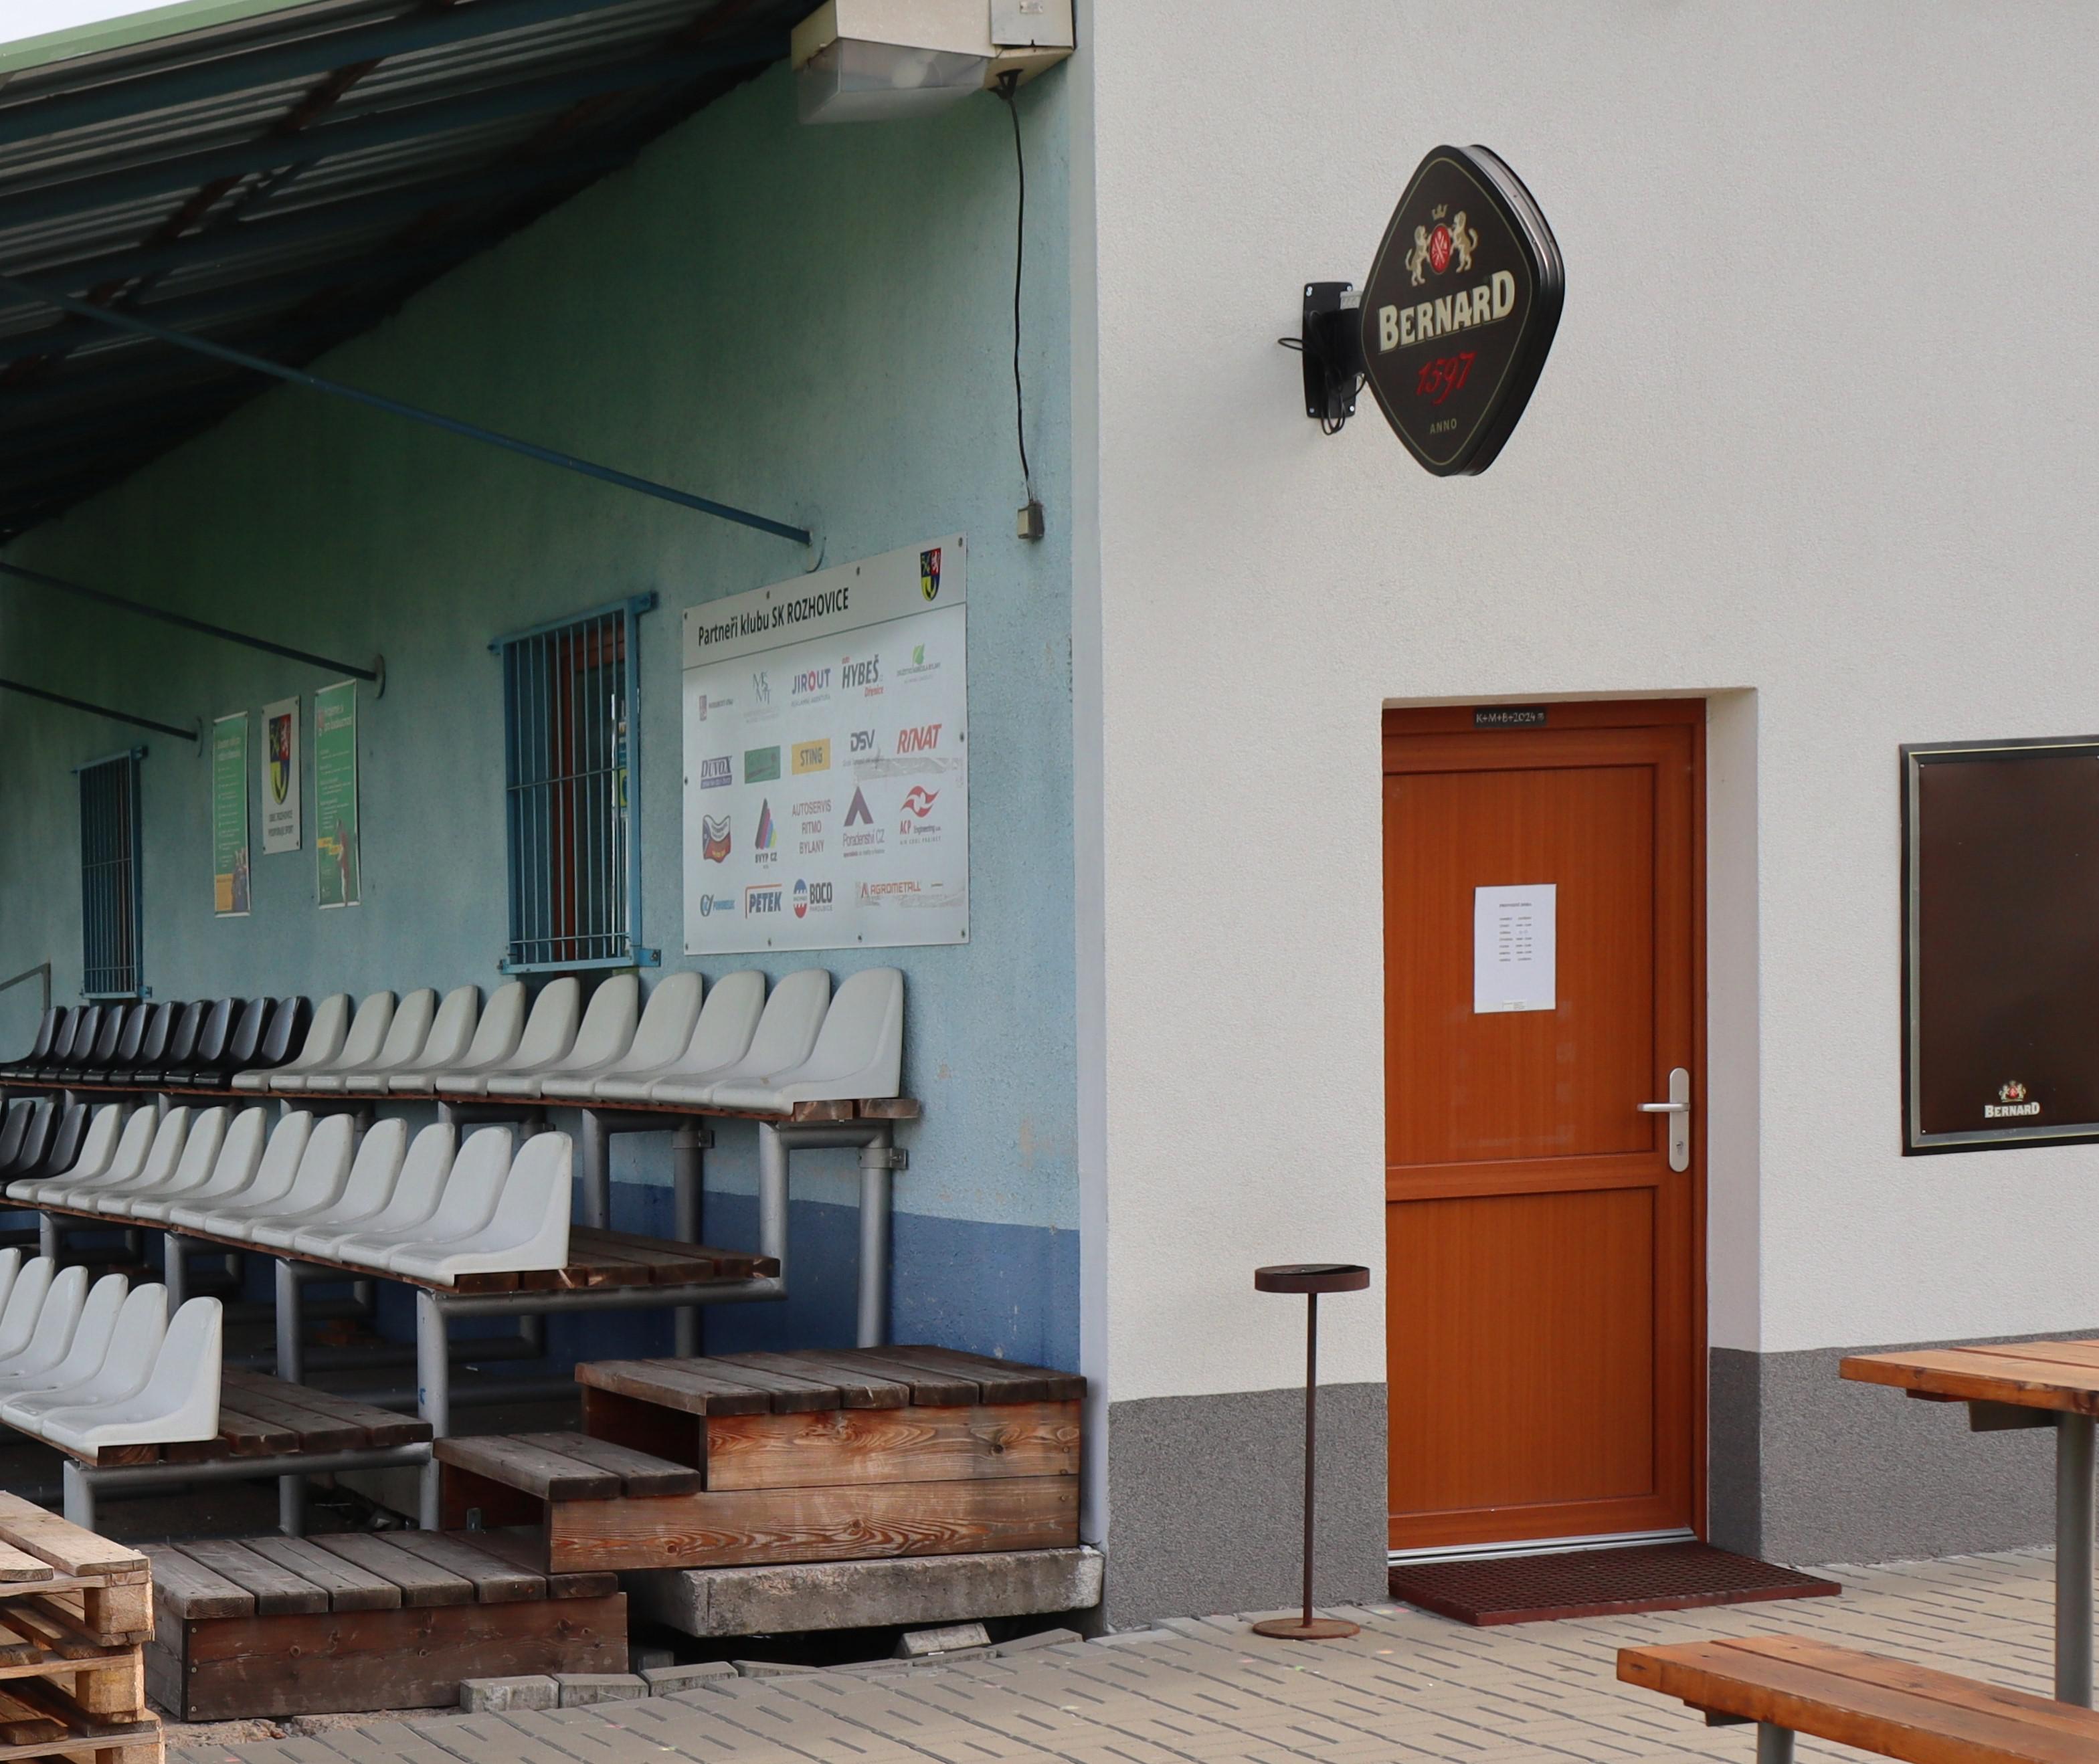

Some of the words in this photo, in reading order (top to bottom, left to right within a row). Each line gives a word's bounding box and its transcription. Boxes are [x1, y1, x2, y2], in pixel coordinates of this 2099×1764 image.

[1379, 270, 1516, 352] BERNARD
[1417, 351, 1477, 405] 1597
[1429, 418, 1457, 434] ANNO
[699, 617, 737, 646] Partneři
[741, 610, 769, 636] klubu
[772, 605, 784, 628] SK
[788, 587, 849, 623] ROZHOVICE
[792, 668, 831, 694] JIROUT
[842, 654, 879, 689] HYBEŠ
[850, 729, 875, 752] DSV
[897, 724, 942, 755] RINAT
[800, 747, 822, 767] STING
[792, 799, 832, 817] AUTOSERVIS
[802, 820, 822, 835] RITMO
[799, 840, 824, 854] BYLANY
[810, 882, 833, 904] BOCO
[871, 881, 921, 895] AGROMETALL
[749, 892, 782, 913] PETEK
[1985, 1102, 2040, 1118] BERNARD
